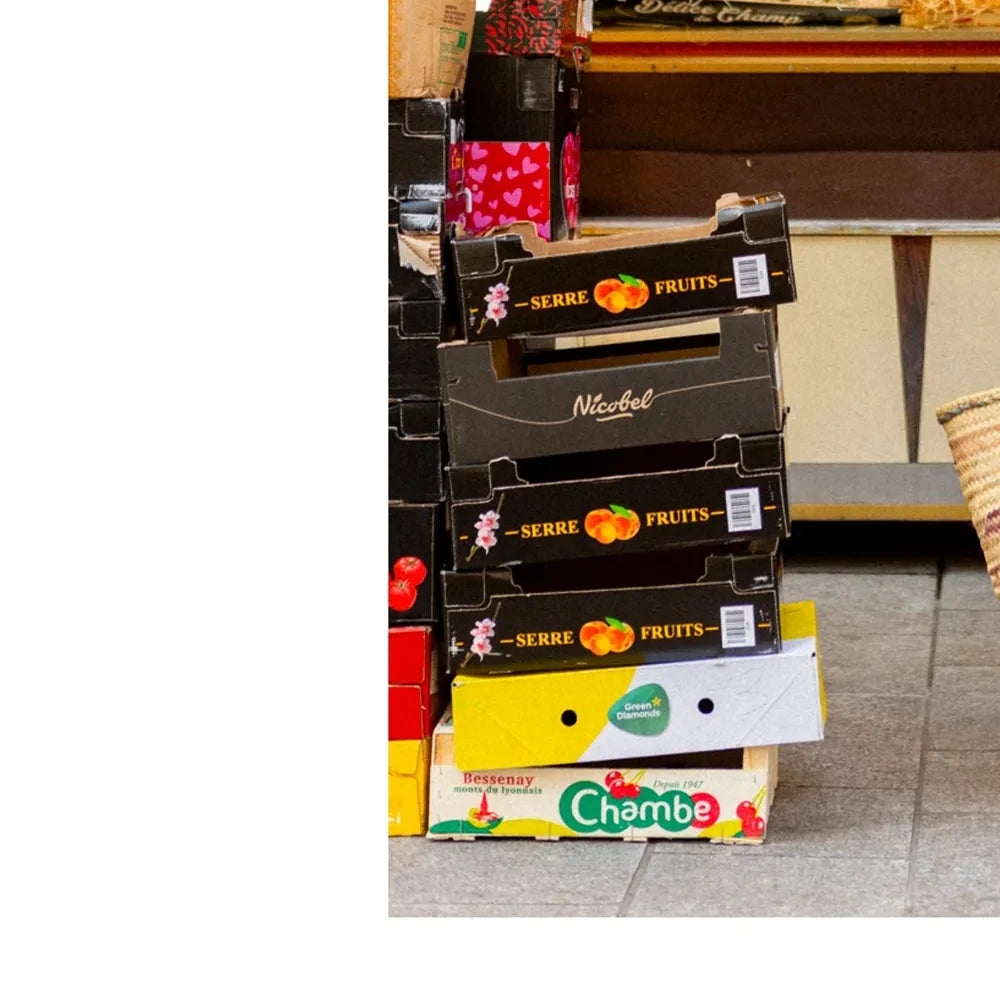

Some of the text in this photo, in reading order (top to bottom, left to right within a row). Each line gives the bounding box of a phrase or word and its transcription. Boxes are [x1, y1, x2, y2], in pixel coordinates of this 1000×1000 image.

[530, 274, 718, 311] SERRE FRUITS
[573, 388, 654, 416] Nicobel
[520, 507, 710, 539] SERRE FRUITS
[515, 622, 704, 648] SERRE FRUITS
[616, 708, 661, 720] Diamonds
[624, 702, 653, 711] Green
[463, 771, 535, 788] Bessenay
[653, 779, 704, 790] Depuis 1947
[486, 785, 498, 794] du
[501, 786, 543, 796] lyonnais
[571, 788, 712, 826] Chambe
